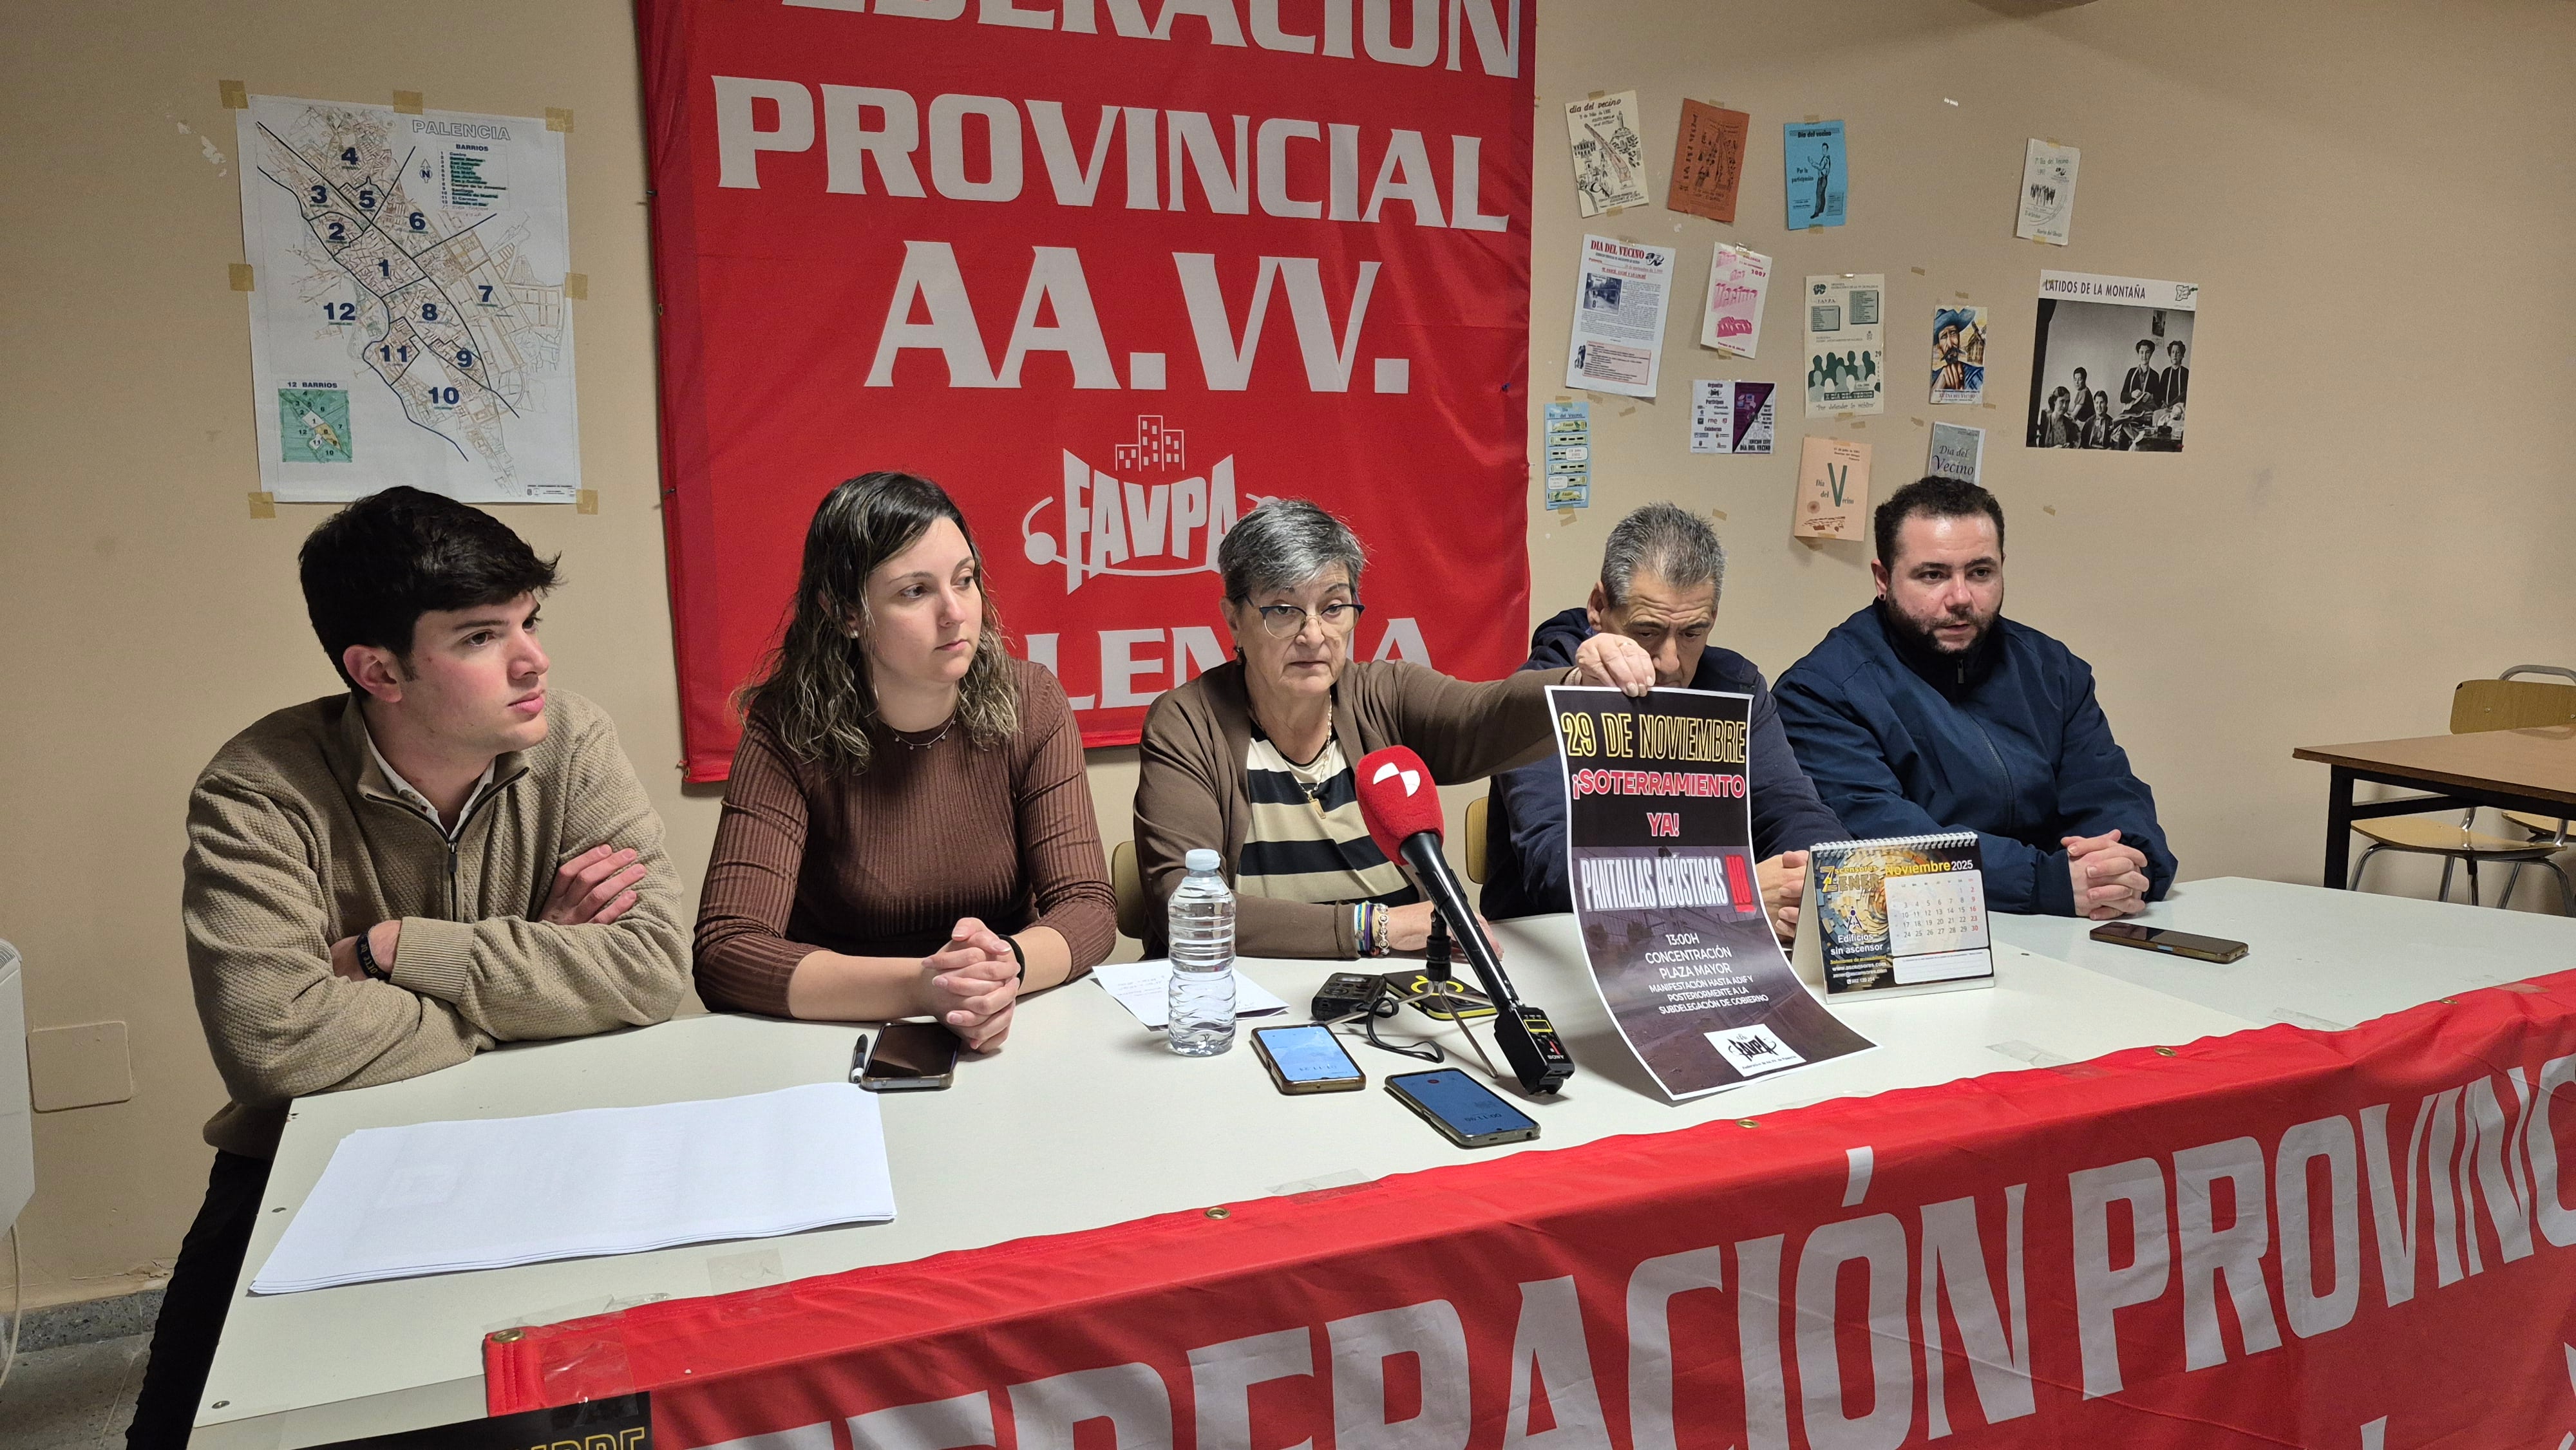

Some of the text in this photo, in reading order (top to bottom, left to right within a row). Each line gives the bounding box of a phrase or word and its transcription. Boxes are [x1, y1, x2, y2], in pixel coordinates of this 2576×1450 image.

[412, 119, 511, 141] PALENCIA
[341, 147, 359, 165] 4
[455, 144, 489, 152] BARRIOS
[712, 75, 1509, 232] PROVINCIAL
[422, 170, 431, 178] N
[311, 185, 328, 203] 3
[359, 190, 375, 209] 5
[409, 212, 426, 230] 6
[328, 222, 345, 241] 2
[1604, 243, 1618, 255] DEL
[1619, 245, 1645, 259] VECINO
[379, 259, 390, 277] 1
[478, 285, 493, 303] 7
[2045, 278, 2146, 299] LATIDOS DE LA MONTAÑA
[323, 302, 356, 321] 12
[422, 303, 439, 321] 8
[864, 241, 1409, 394] AA.VV.
[380, 344, 408, 362] 11
[456, 350, 473, 368] 9
[428, 386, 460, 405] 10
[1956, 447, 1971, 458] del
[1933, 455, 1974, 476] Vecino
[1063, 448, 1238, 596] FAVPA
[1560, 712, 1747, 764] 29 DE NOVIEMBRE
[1572, 768, 1746, 800] ¡SOTERRAMIENTO
[1646, 813, 1680, 837] YA!
[1885, 860, 1973, 876] Noviembre 2025
[1580, 858, 1657, 911] PANTALLAS
[1654, 852, 1728, 908] ACÚSTICAS
[1665, 932, 1700, 946] 13:00H
[1837, 934, 1873, 943] Edificios
[1645, 945, 1732, 964] CONCENTRACIÓN
[1830, 944, 1883, 956] sin ascensor
[1659, 962, 1732, 979] PLAZA MAYOR
[1649, 978, 1707, 993] MANIFESTACIÓN
[1707, 977, 1733, 987] HASTA
[1732, 975, 1748, 985] ADIF
[1667, 988, 1733, 1003] POSTERIORMENTE
[1739, 986, 1750, 994] LA
[1658, 994, 1769, 1015] SUBDELEGACIÓN DE GOBIERNO
